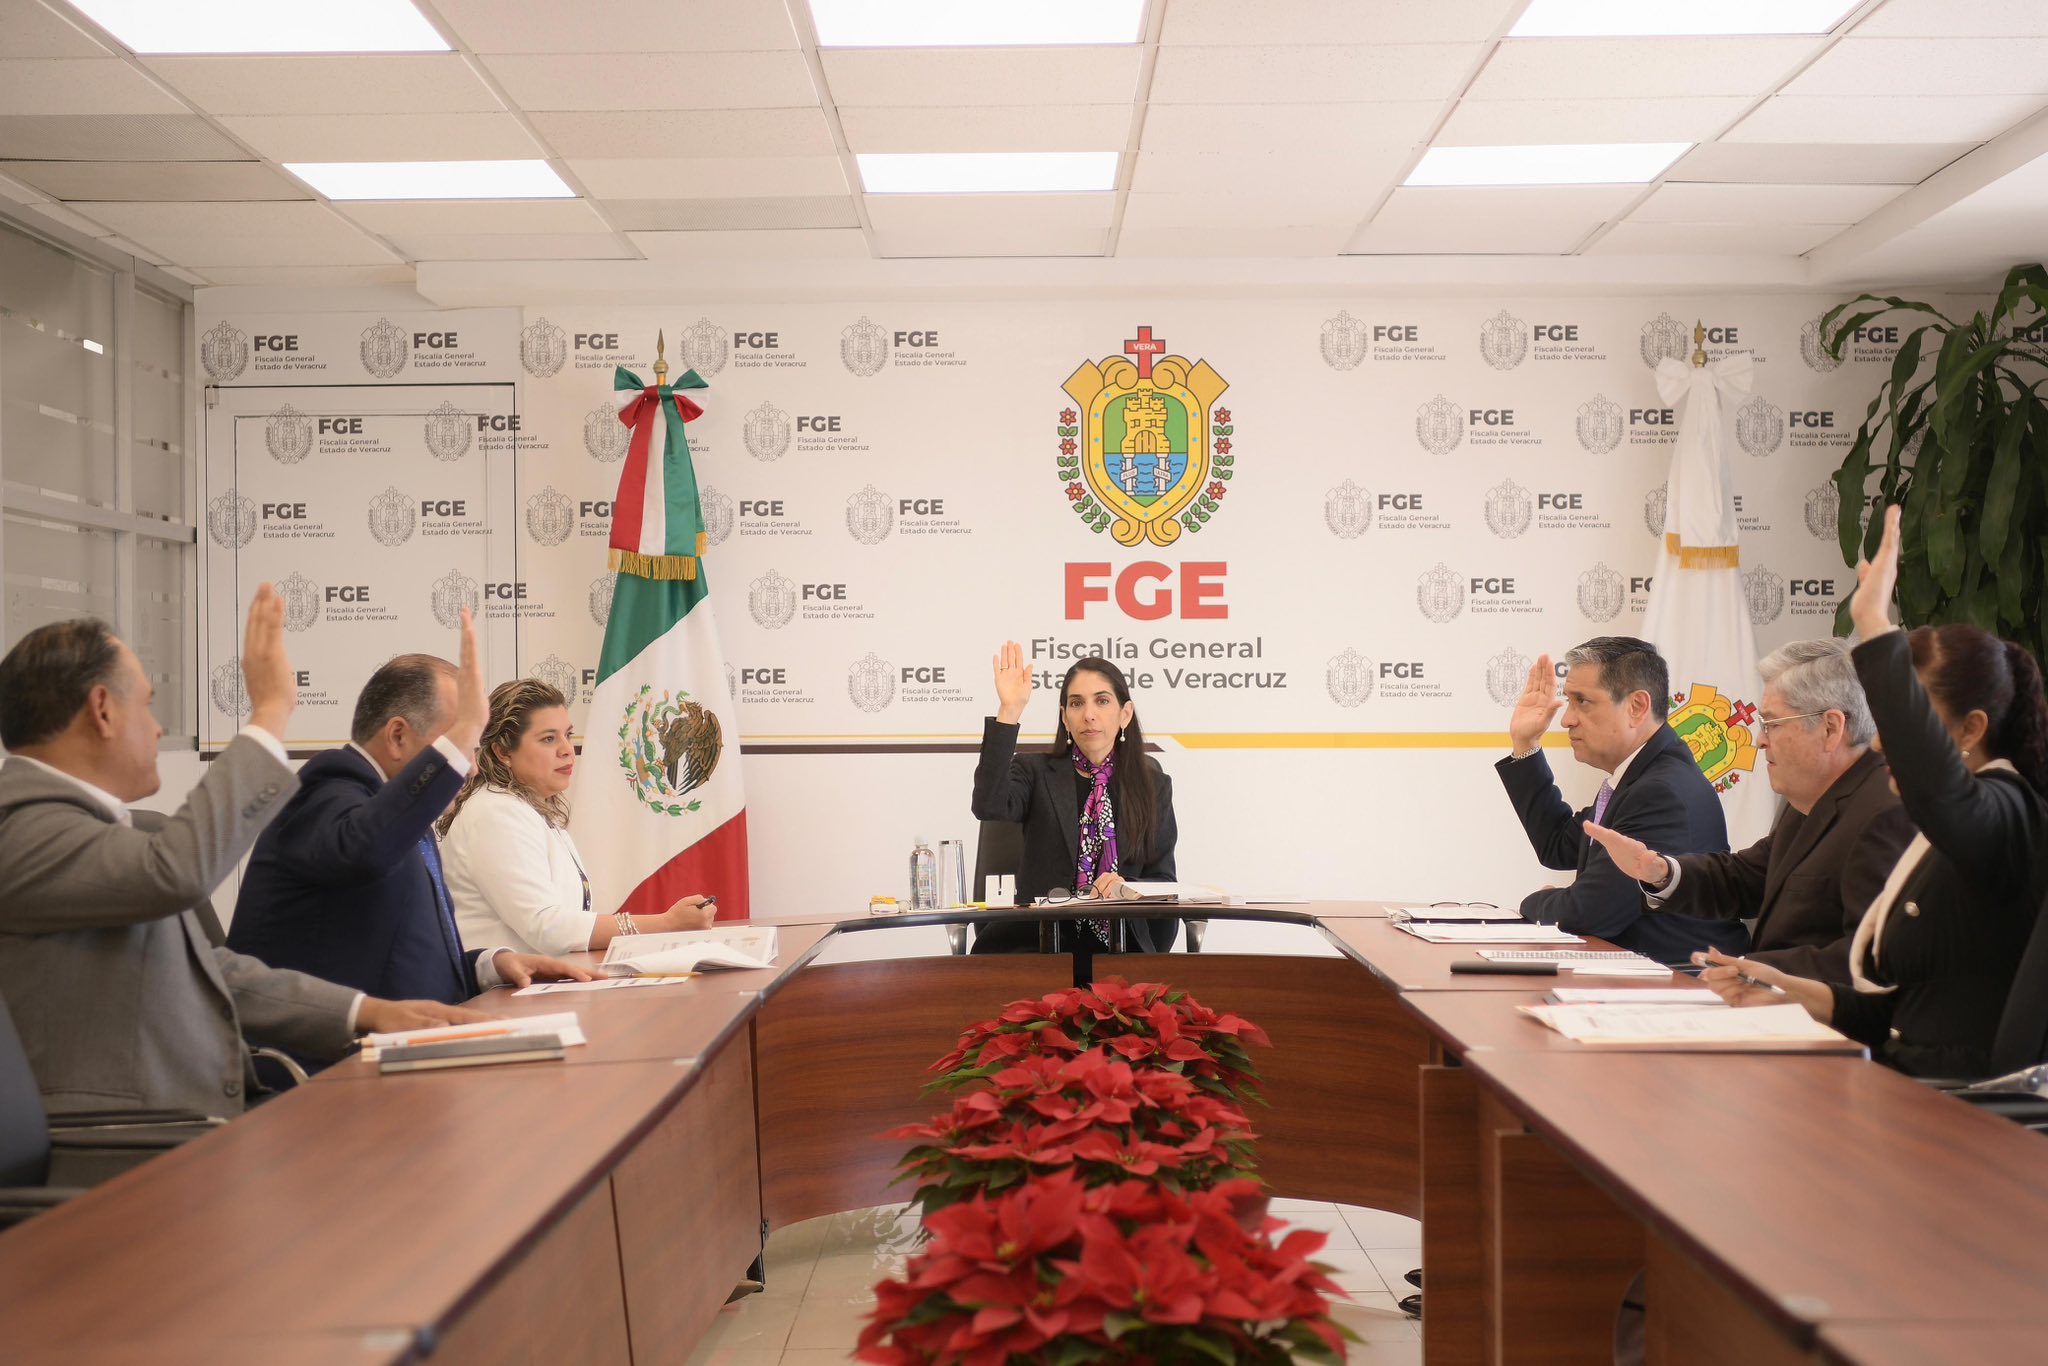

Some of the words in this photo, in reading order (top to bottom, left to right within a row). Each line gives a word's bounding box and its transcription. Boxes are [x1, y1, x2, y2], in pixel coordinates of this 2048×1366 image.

[413, 332, 458, 348] FGE
[574, 333, 619, 349] FGE
[734, 332, 778, 348] FGE
[894, 331, 938, 347] FGE
[1373, 325, 1418, 342] FGE
[1534, 325, 1578, 341] FGE
[1854, 327, 1898, 343] FGE
[254, 335, 298, 351] FGE
[1133, 343, 1157, 351] VERA
[444, 352, 474, 360] General
[765, 352, 795, 360] General
[477, 415, 522, 431] FGE
[797, 416, 841, 432] FGE
[1469, 409, 1514, 426] FGE
[1629, 409, 1674, 425] FGE
[1789, 411, 1834, 427] FGE
[318, 418, 363, 434] FGE
[349, 438, 379, 446] General
[421, 500, 466, 516] FGE
[739, 500, 784, 516] FGE
[899, 499, 944, 515] FGE
[1378, 494, 1423, 510] FGE
[1538, 493, 1583, 510] FGE
[262, 503, 307, 519] FGE
[452, 520, 482, 528] General
[770, 520, 800, 528] General
[325, 586, 370, 602] FGE
[484, 583, 528, 599] FGE
[802, 584, 847, 600] FGE
[1064, 560, 1229, 620] FGE
[1470, 578, 1515, 594] FGE
[1789, 579, 1834, 596] FGE
[1031, 636, 1139, 659] Fiscalía
[1149, 636, 1262, 659] General
[741, 668, 786, 684] FGE
[901, 667, 946, 683] FGE
[1129, 667, 1154, 689] de
[1163, 667, 1287, 689] Veracruz
[1380, 662, 1424, 678] FGE
[772, 688, 802, 696] General
[1410, 682, 1440, 690] General
